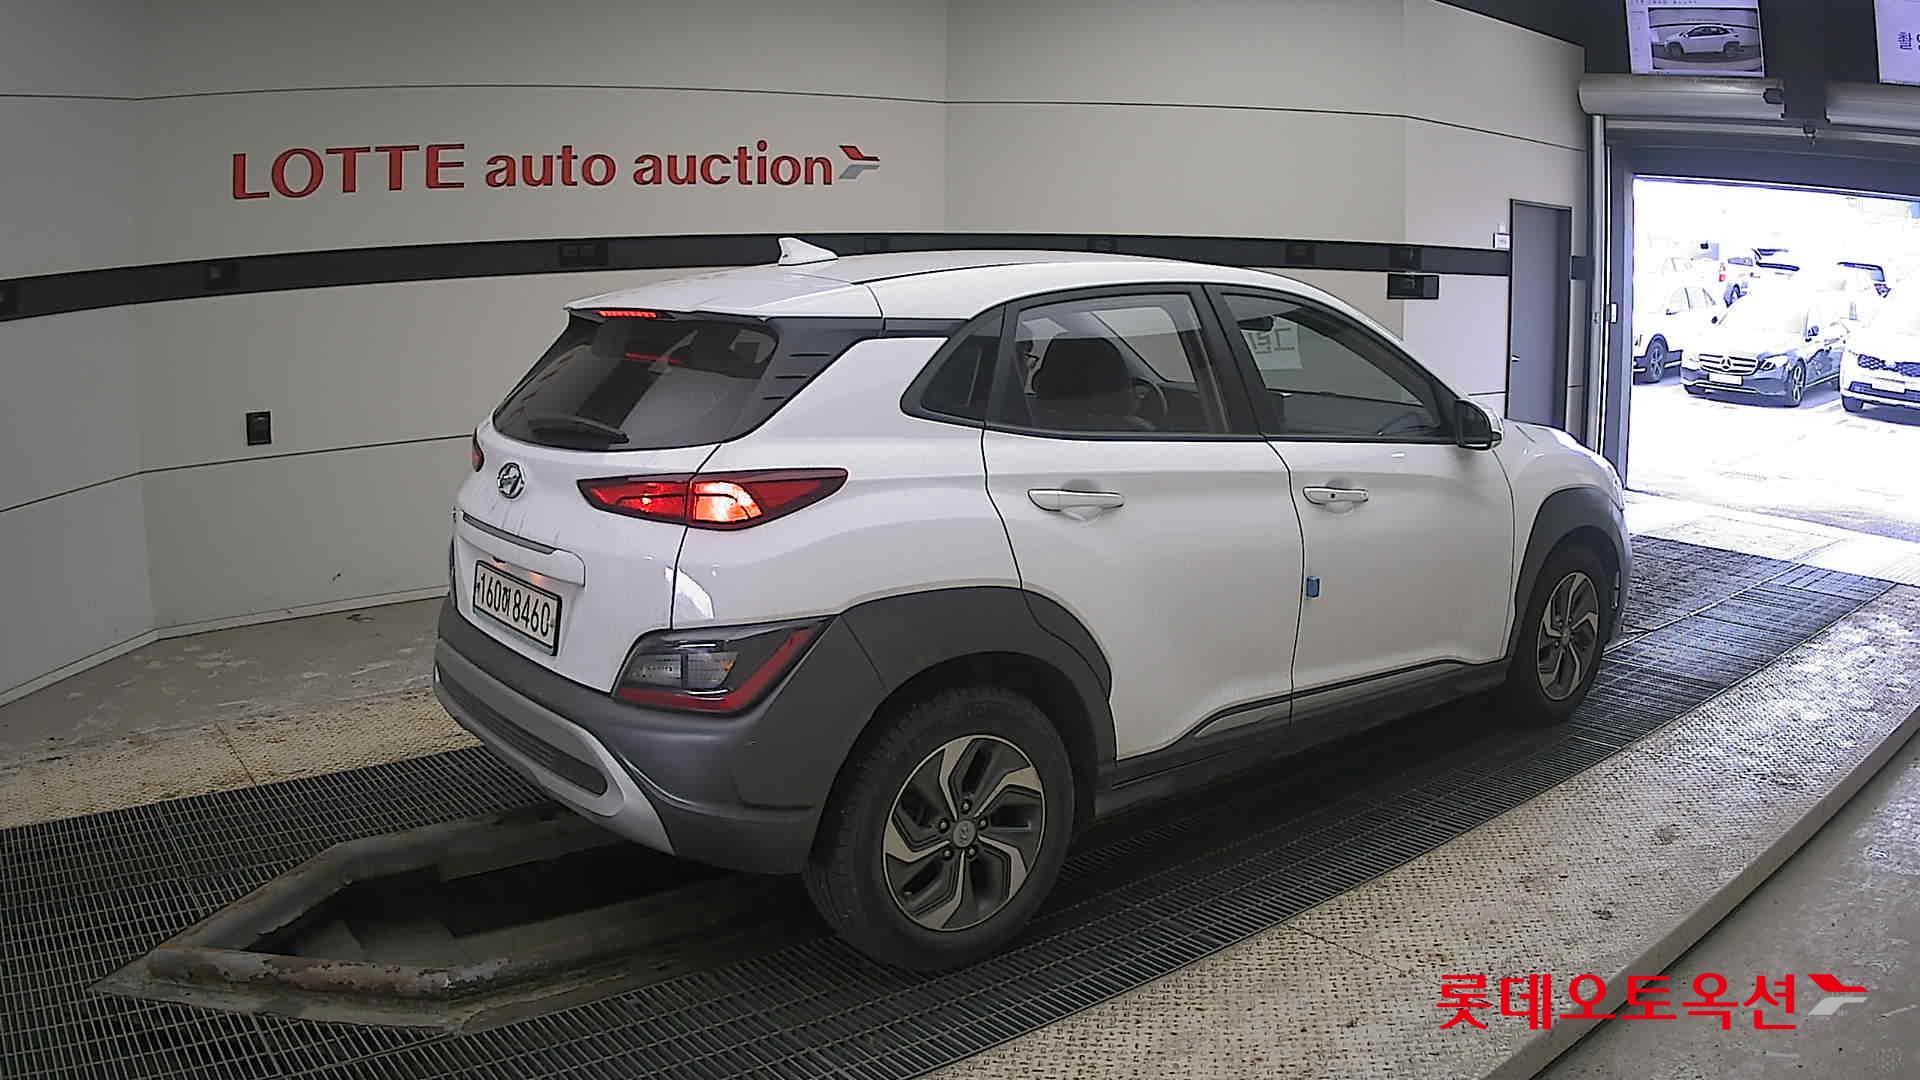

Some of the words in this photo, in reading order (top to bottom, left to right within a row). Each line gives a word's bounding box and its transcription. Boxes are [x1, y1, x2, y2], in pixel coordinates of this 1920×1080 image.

[1897, 31, 1920, 50] 촬
[232, 143, 466, 200] LOTTE
[485, 144, 617, 188] auto
[633, 140, 834, 187] auction
